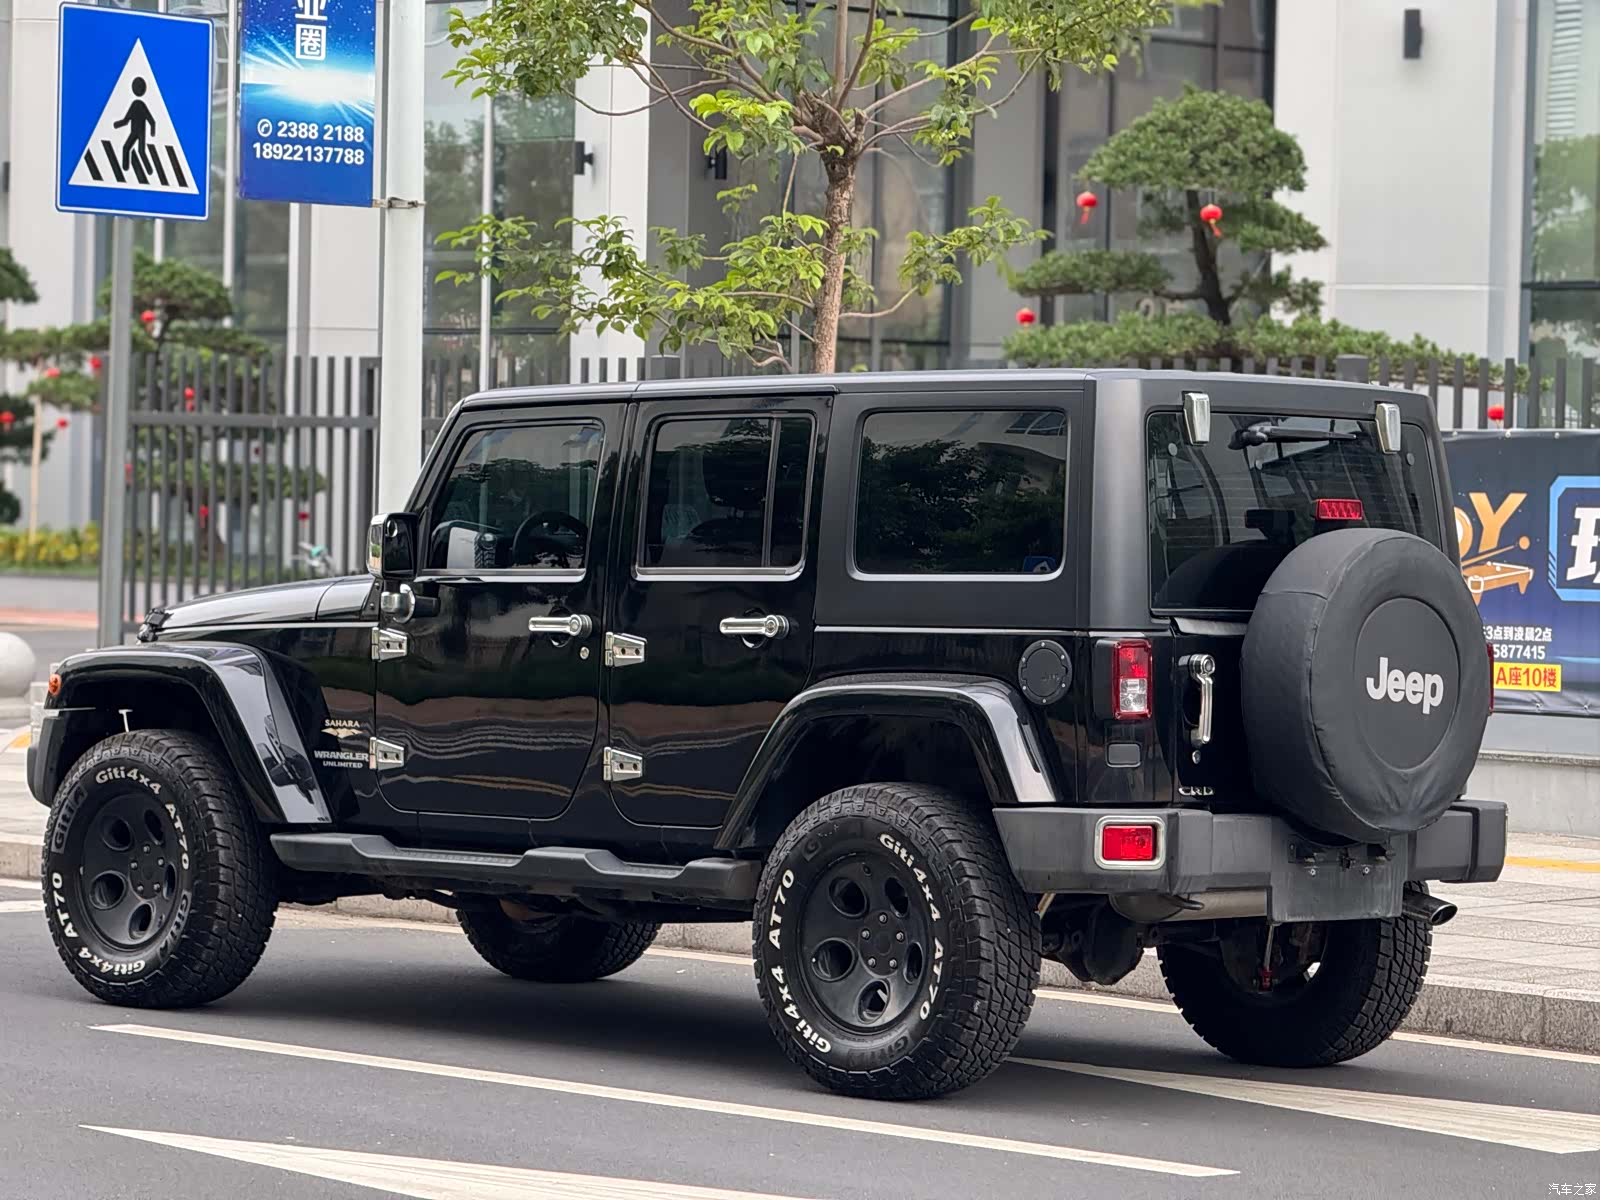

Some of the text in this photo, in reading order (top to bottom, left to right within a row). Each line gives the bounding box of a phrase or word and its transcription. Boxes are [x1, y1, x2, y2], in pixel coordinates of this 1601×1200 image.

[277, 121, 365, 143] 2388 2188
[252, 142, 365, 165] 18922137788
[1366, 656, 1444, 715] Jeep
[1495, 666, 1558, 689] A座10楼
[324, 719, 361, 728] SAHARA
[313, 750, 370, 762] WRANGLER
[322, 760, 364, 769] UNLIMITED
[165, 803, 190, 870] AT70
[52, 872, 79, 938] AT70
[768, 869, 795, 950] AT70
